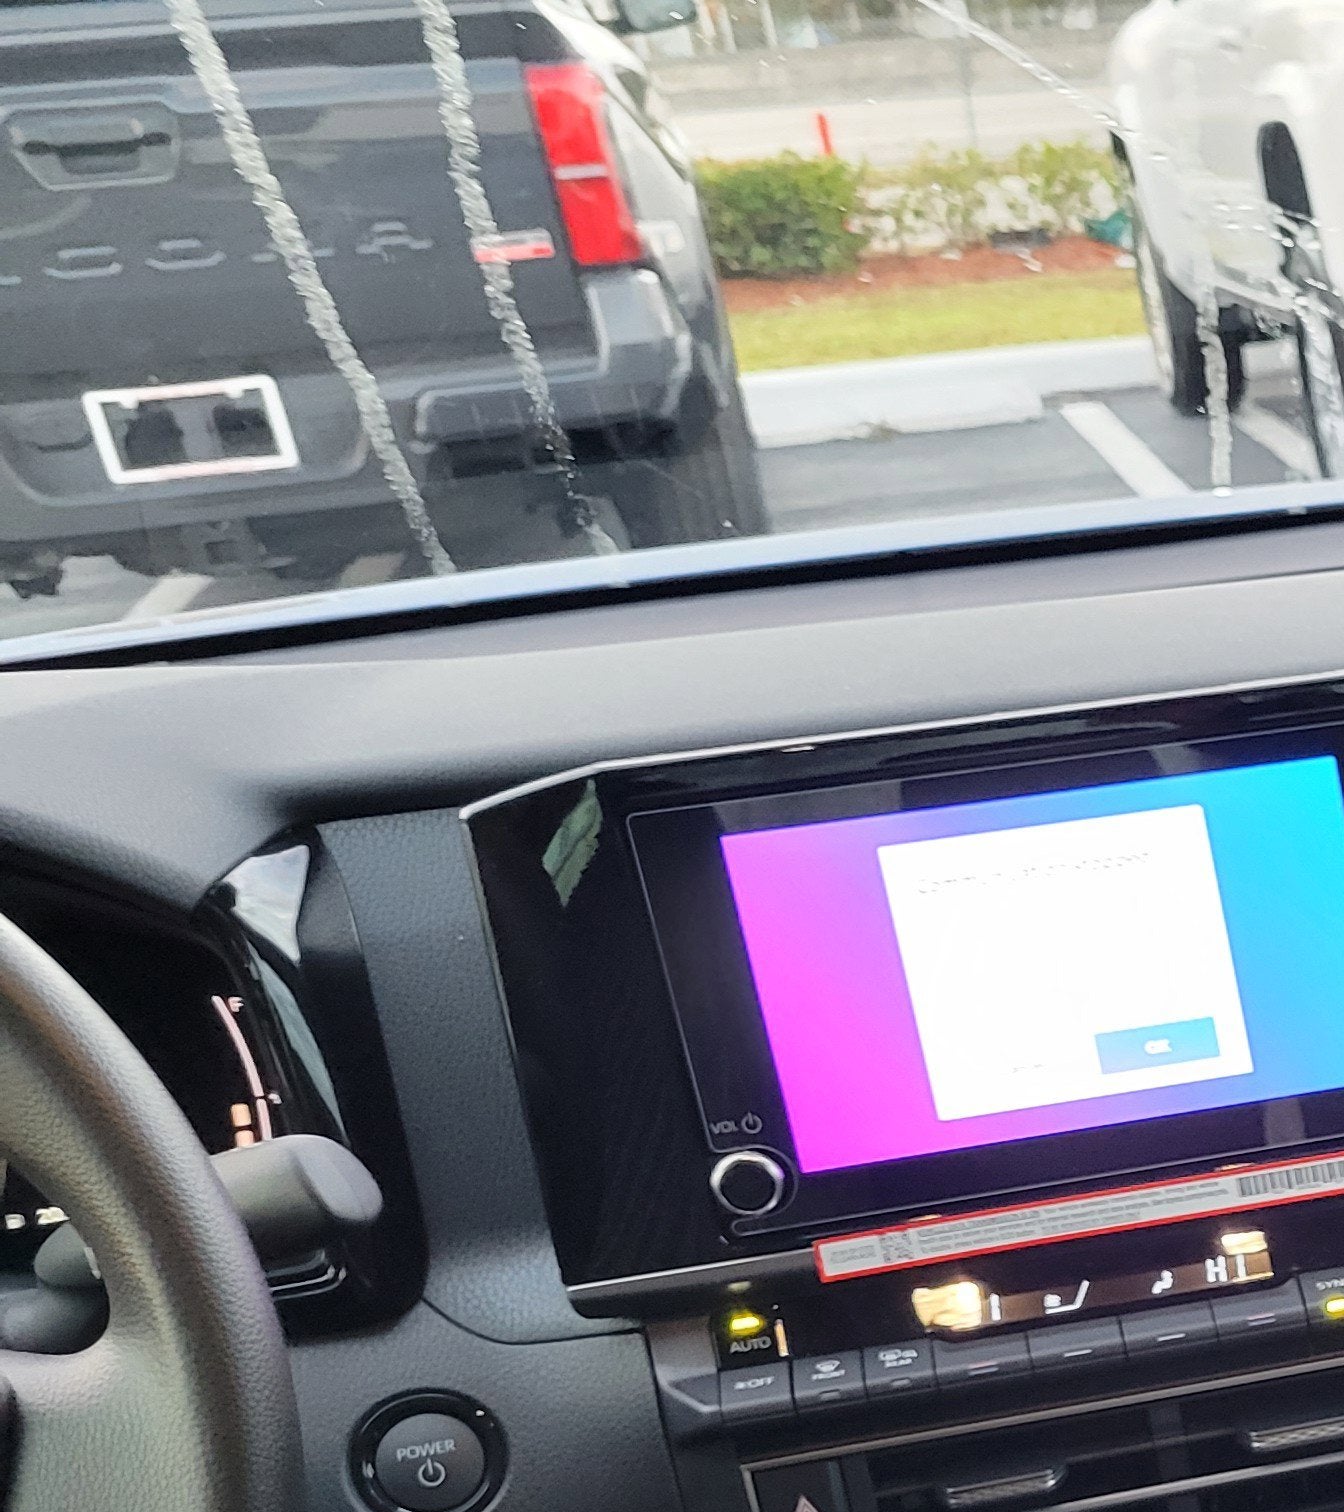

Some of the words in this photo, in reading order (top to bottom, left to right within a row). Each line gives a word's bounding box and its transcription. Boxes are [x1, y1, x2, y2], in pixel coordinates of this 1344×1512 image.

[709, 1120, 739, 1135] VOL
[729, 1335, 773, 1354] AUTO
[396, 1438, 456, 1462] POWER
